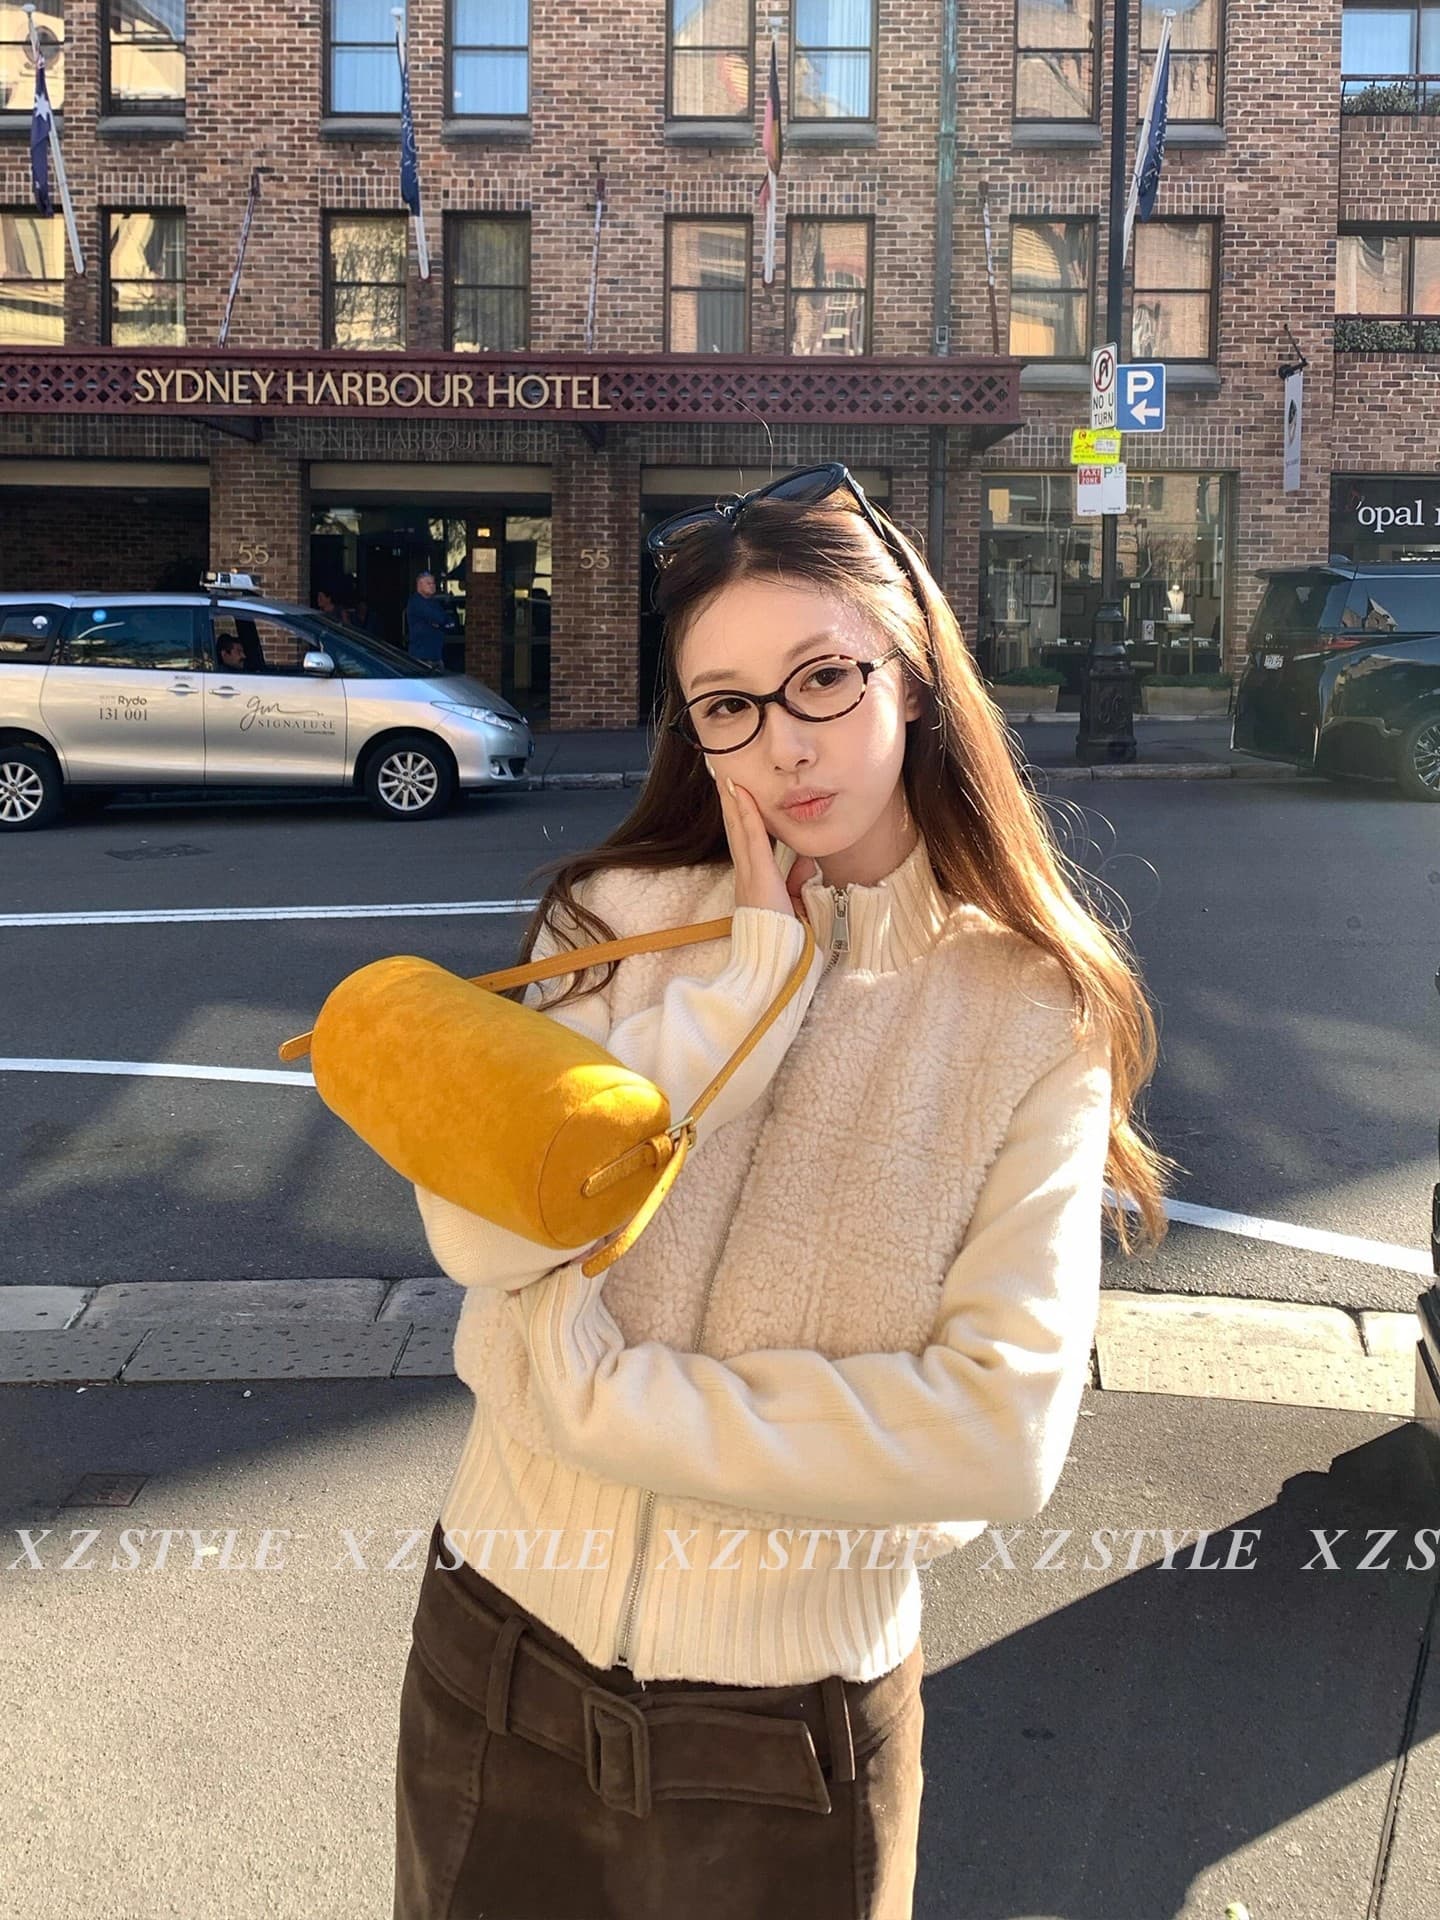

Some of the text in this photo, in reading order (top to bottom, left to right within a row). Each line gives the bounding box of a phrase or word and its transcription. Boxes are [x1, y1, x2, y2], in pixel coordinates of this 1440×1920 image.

[134, 369, 612, 409] SYDNEY HARBOUR HOTEL
[1127, 370, 1155, 405] P
[1092, 391, 1114, 410] NO U
[1093, 413, 1113, 426] TURN
[1080, 469, 1101, 477] TAXI
[238, 543, 270, 565] 55
[579, 548, 611, 570] 55
[118, 695, 147, 707] Rydo
[99, 707, 148, 721] 131 001
[257, 719, 336, 729] SIGNATURE
